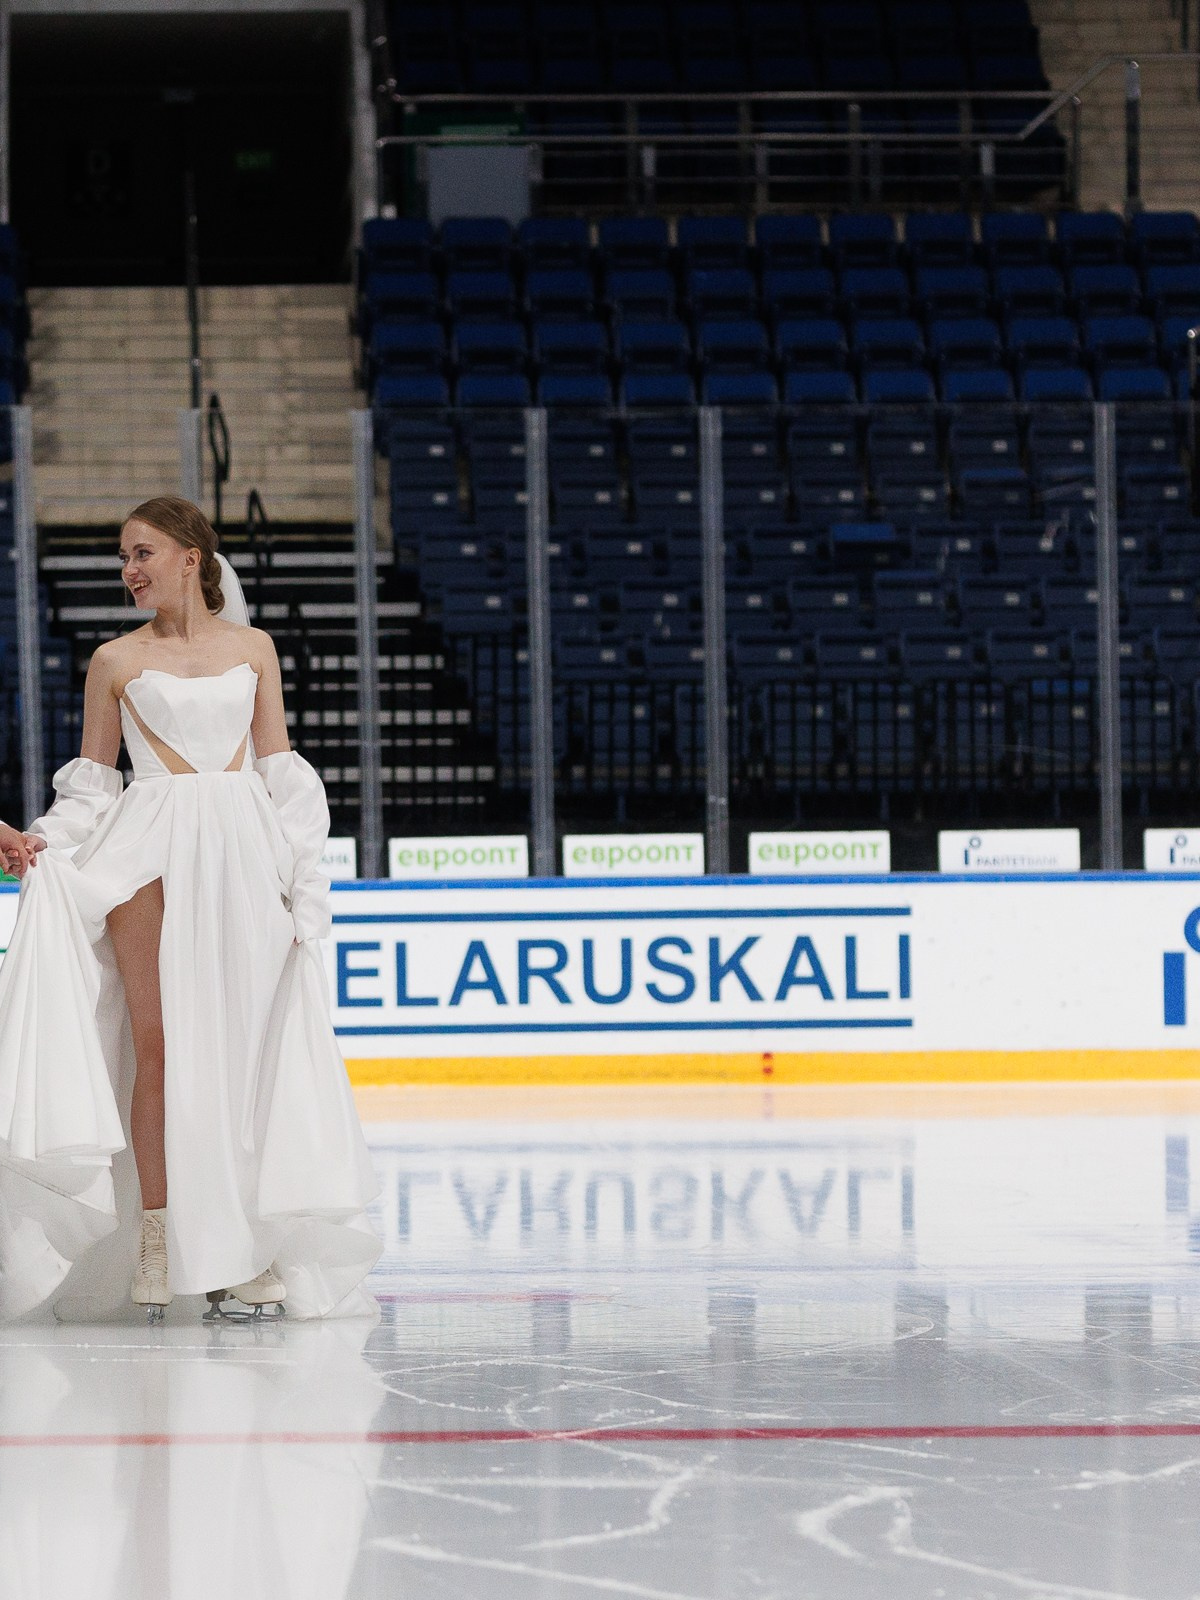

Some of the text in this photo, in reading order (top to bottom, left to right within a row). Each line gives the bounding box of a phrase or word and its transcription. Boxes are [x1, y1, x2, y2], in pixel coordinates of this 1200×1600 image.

[398, 846, 519, 870] евроопт
[572, 843, 695, 868] евроопт
[757, 841, 882, 866] евроопт
[335, 933, 911, 1008] ELARUSKALI
